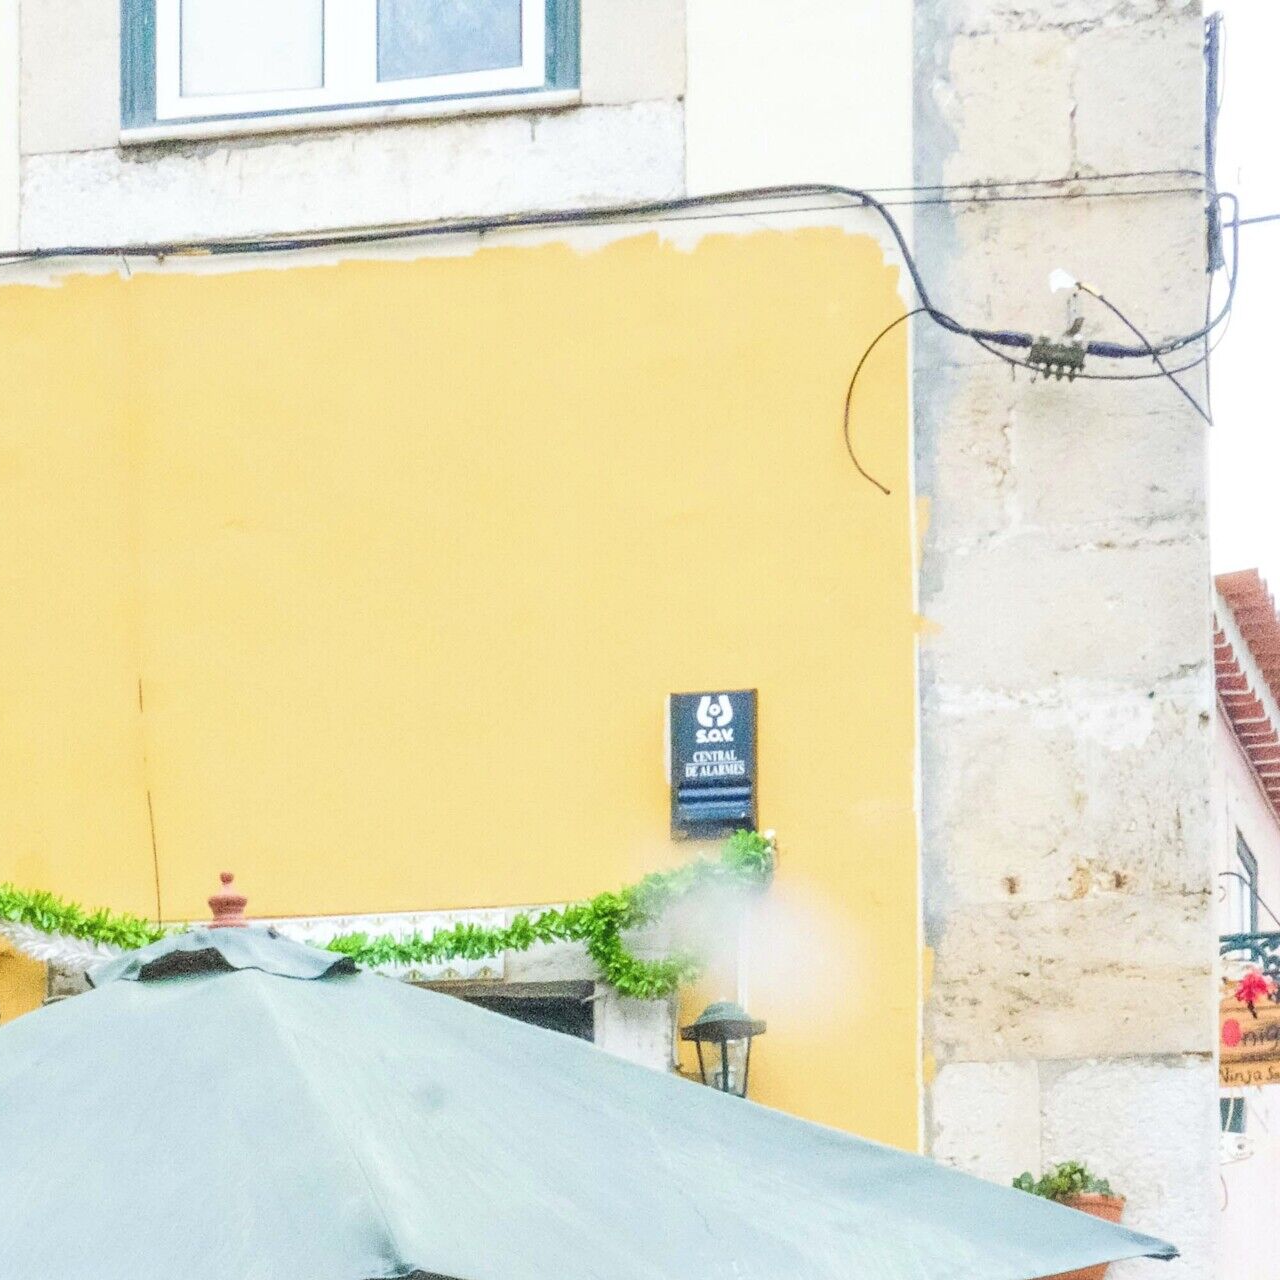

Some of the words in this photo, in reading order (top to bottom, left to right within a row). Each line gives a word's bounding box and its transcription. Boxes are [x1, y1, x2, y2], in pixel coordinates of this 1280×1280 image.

[692, 750, 738, 763] CENTRAL
[685, 764, 699, 778] DE
[700, 761, 745, 777] ALARMES
